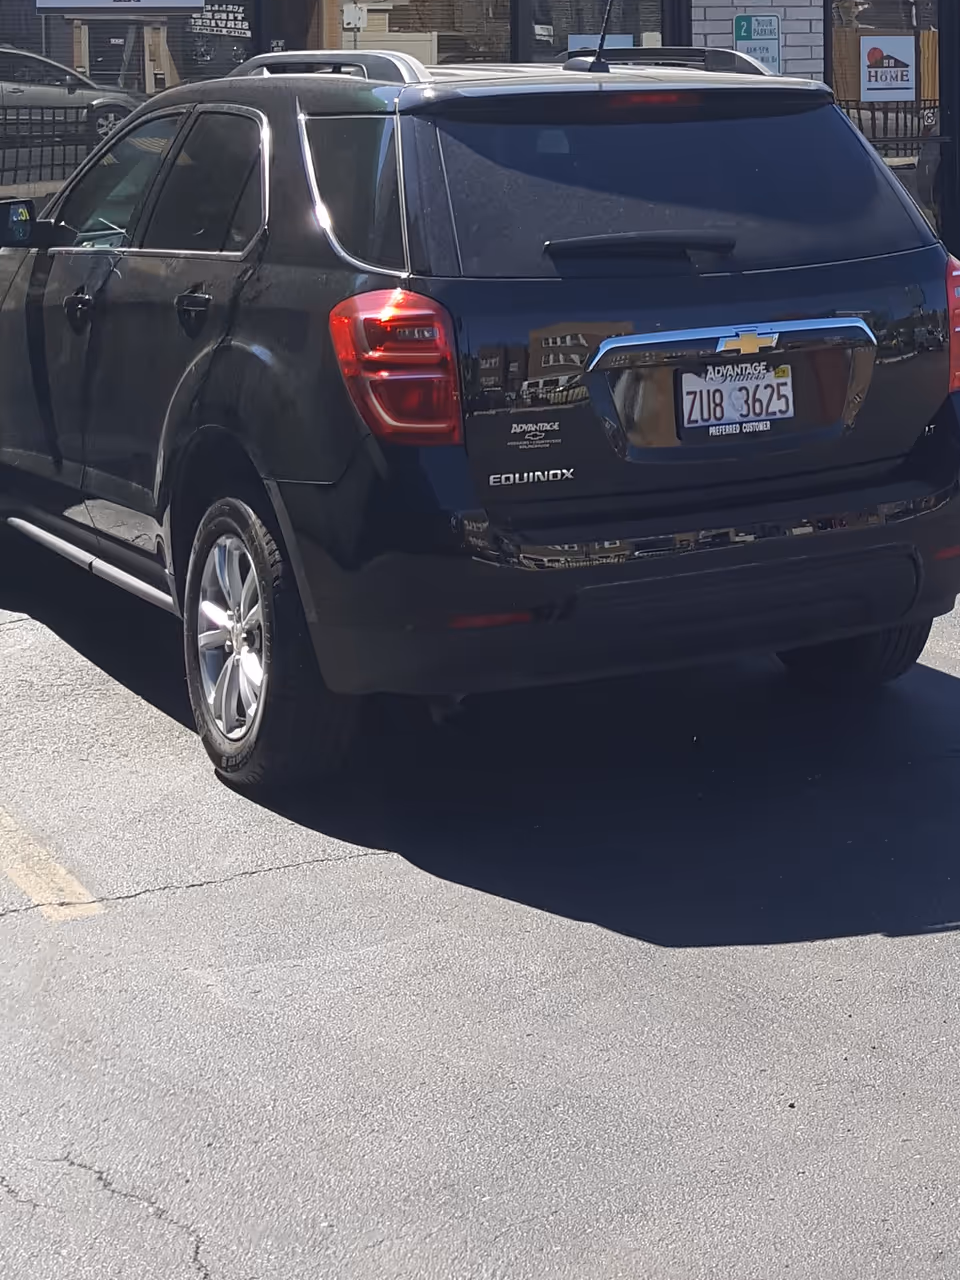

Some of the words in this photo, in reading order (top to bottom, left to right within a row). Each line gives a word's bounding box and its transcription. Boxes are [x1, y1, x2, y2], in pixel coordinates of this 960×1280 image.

[740, 21, 748, 36] 2
[753, 27, 777, 37] PARKING
[867, 69, 910, 83] HOME
[705, 361, 768, 381] ADVANTAGE
[686, 388, 725, 425] ZU8
[737, 382, 790, 418] 3625
[510, 422, 560, 433] ADVANTAGE
[708, 423, 740, 436] PREFERRED
[742, 421, 771, 433] CUSTOMER
[489, 468, 575, 486] EQUINOX
